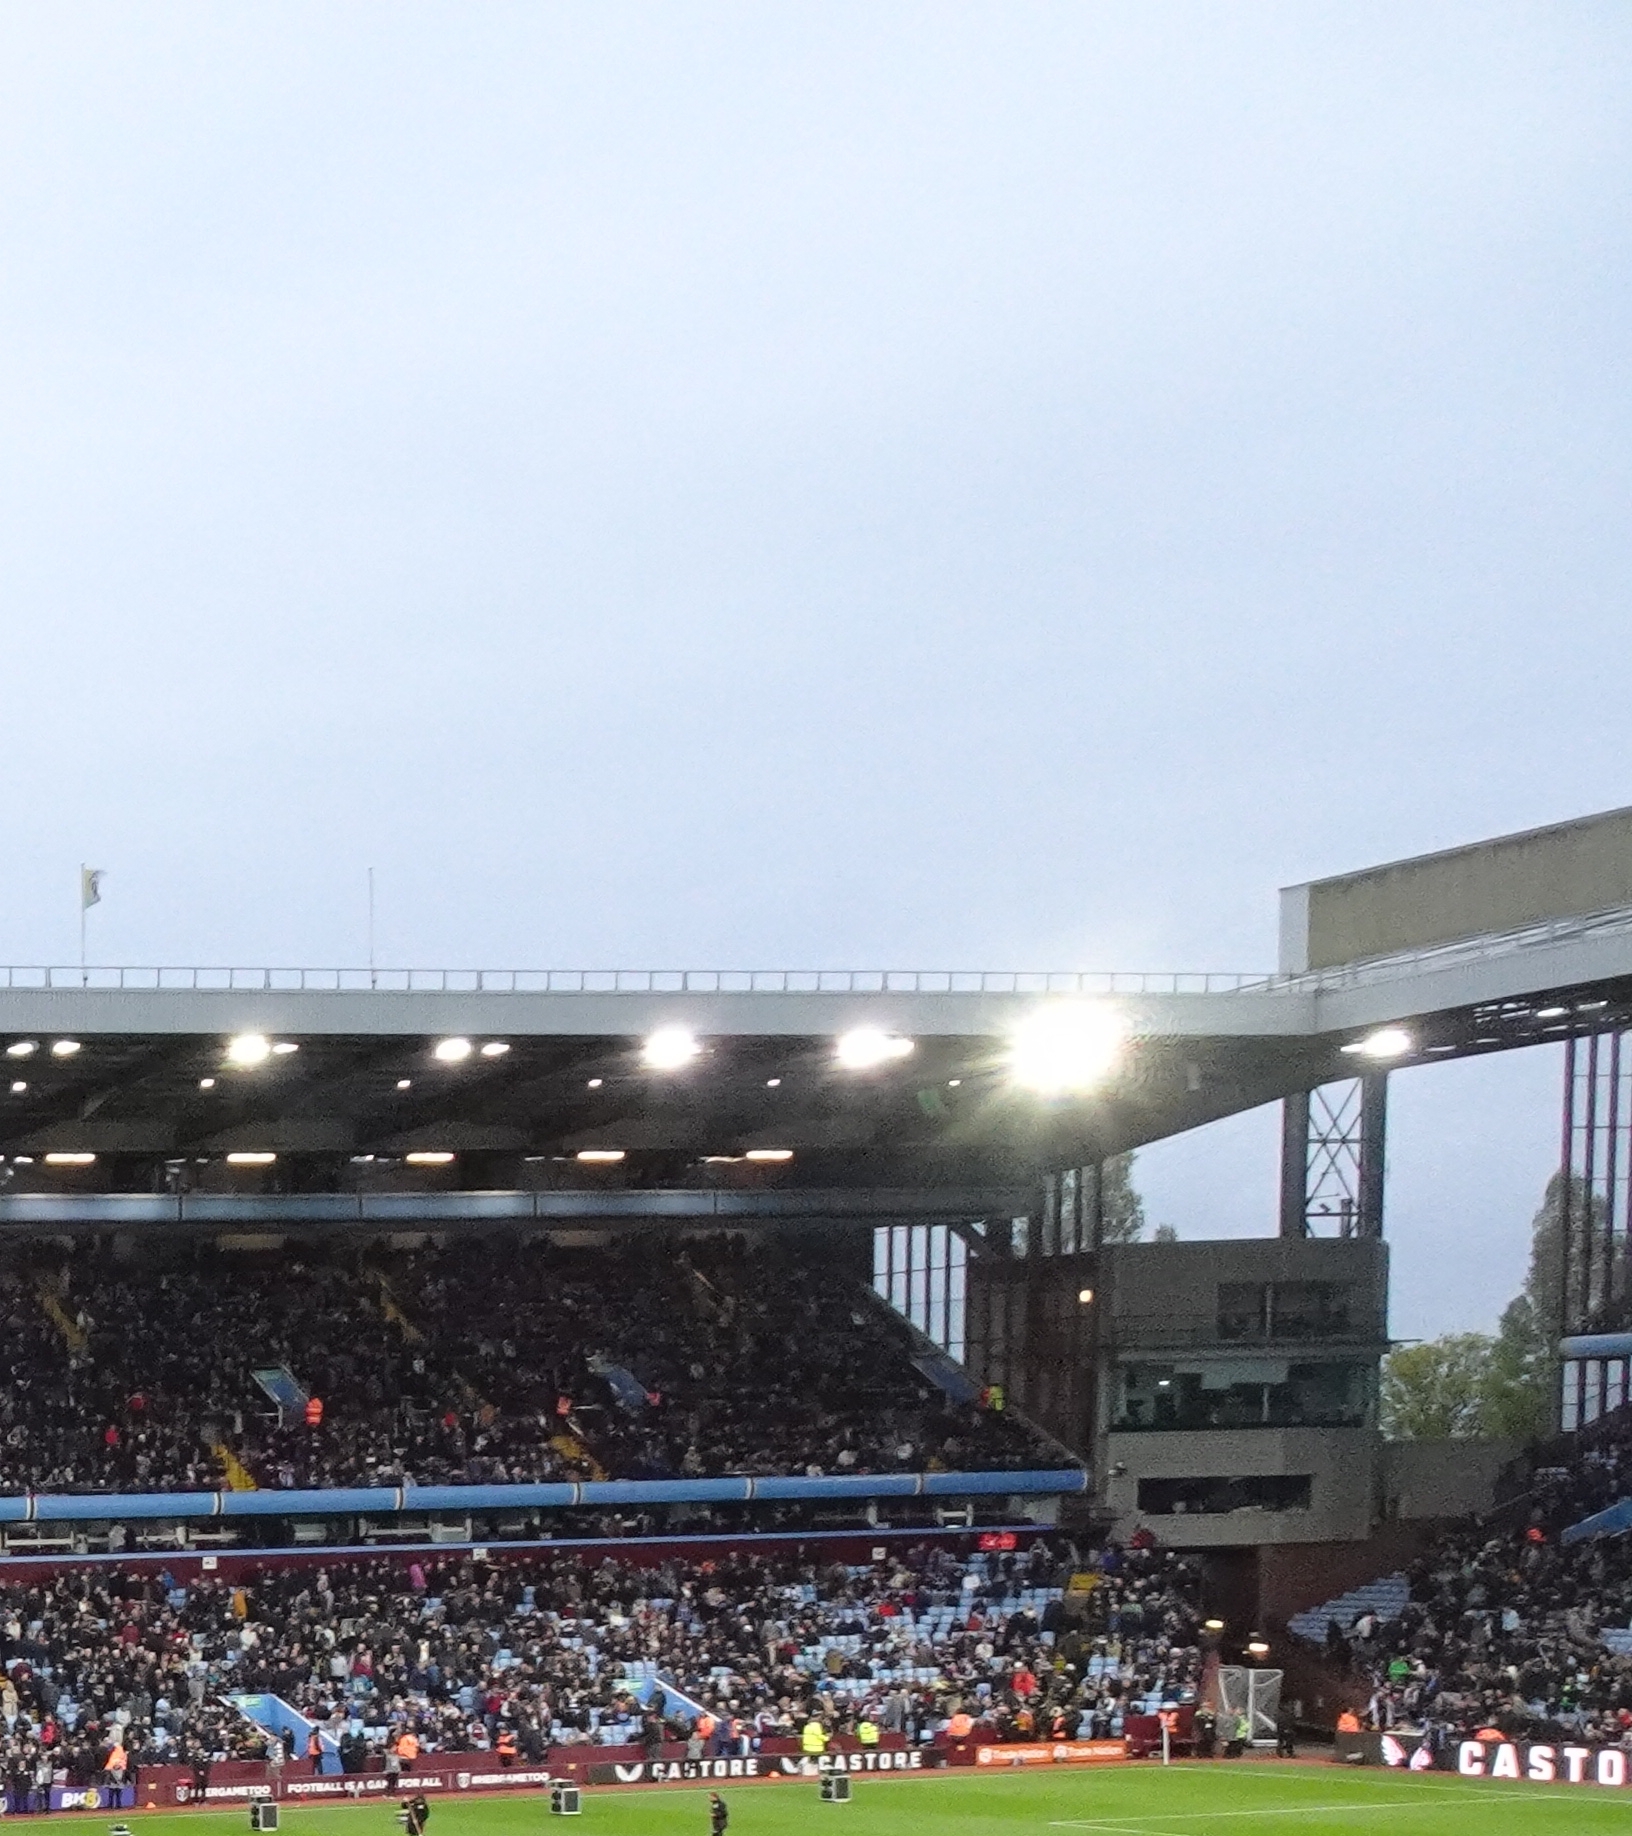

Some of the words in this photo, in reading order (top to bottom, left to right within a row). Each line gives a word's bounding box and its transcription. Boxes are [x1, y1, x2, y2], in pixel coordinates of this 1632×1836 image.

[818, 1751, 923, 1770] CASTORE
[1458, 1741, 1627, 1786] CASTO
[287, 1782, 344, 1793] FOOTBALL
[356, 1781, 365, 1790] A
[398, 1778, 420, 1788] FOR
[421, 1777, 442, 1787] ALL
